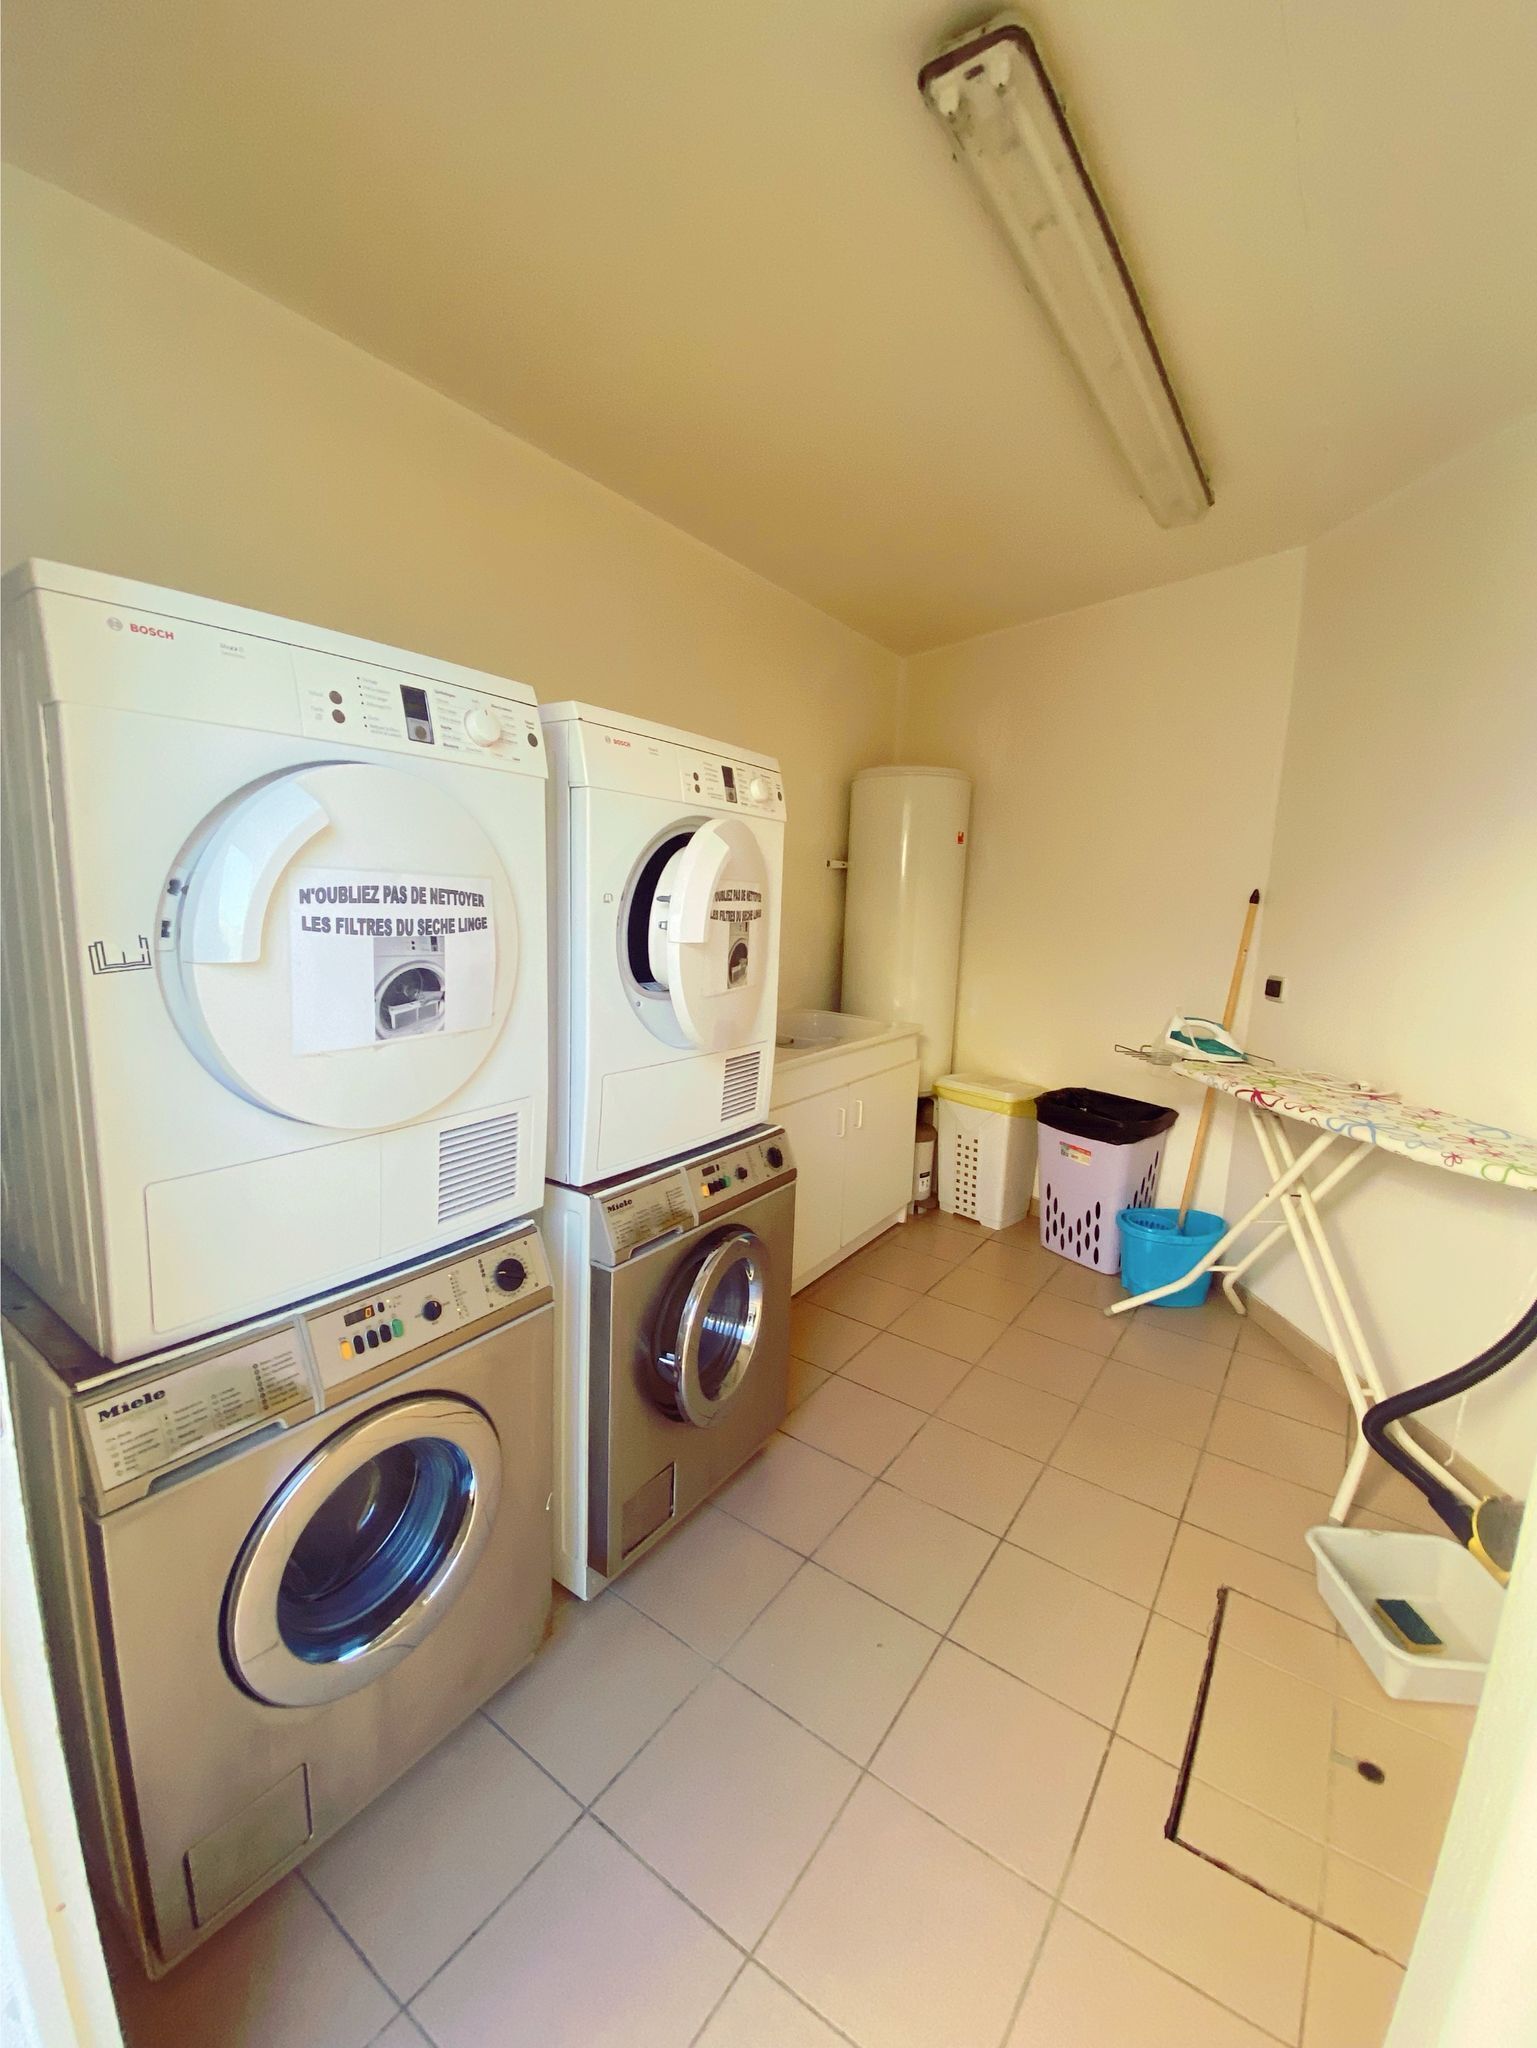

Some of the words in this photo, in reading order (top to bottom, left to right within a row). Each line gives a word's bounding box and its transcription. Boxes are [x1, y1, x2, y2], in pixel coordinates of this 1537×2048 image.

[129, 623, 175, 640] BOSCH
[298, 885, 380, 904] N'OUBLIEZ
[383, 885, 408, 904] PAS
[411, 886, 427, 904] DE
[430, 888, 485, 908] NETTOYER
[301, 915, 331, 933] LES
[335, 917, 393, 936] FILTRES
[396, 918, 414, 936] DU
[417, 917, 456, 936] SECHE
[458, 917, 488, 933] LINGE
[97, 1389, 166, 1423] Miele
